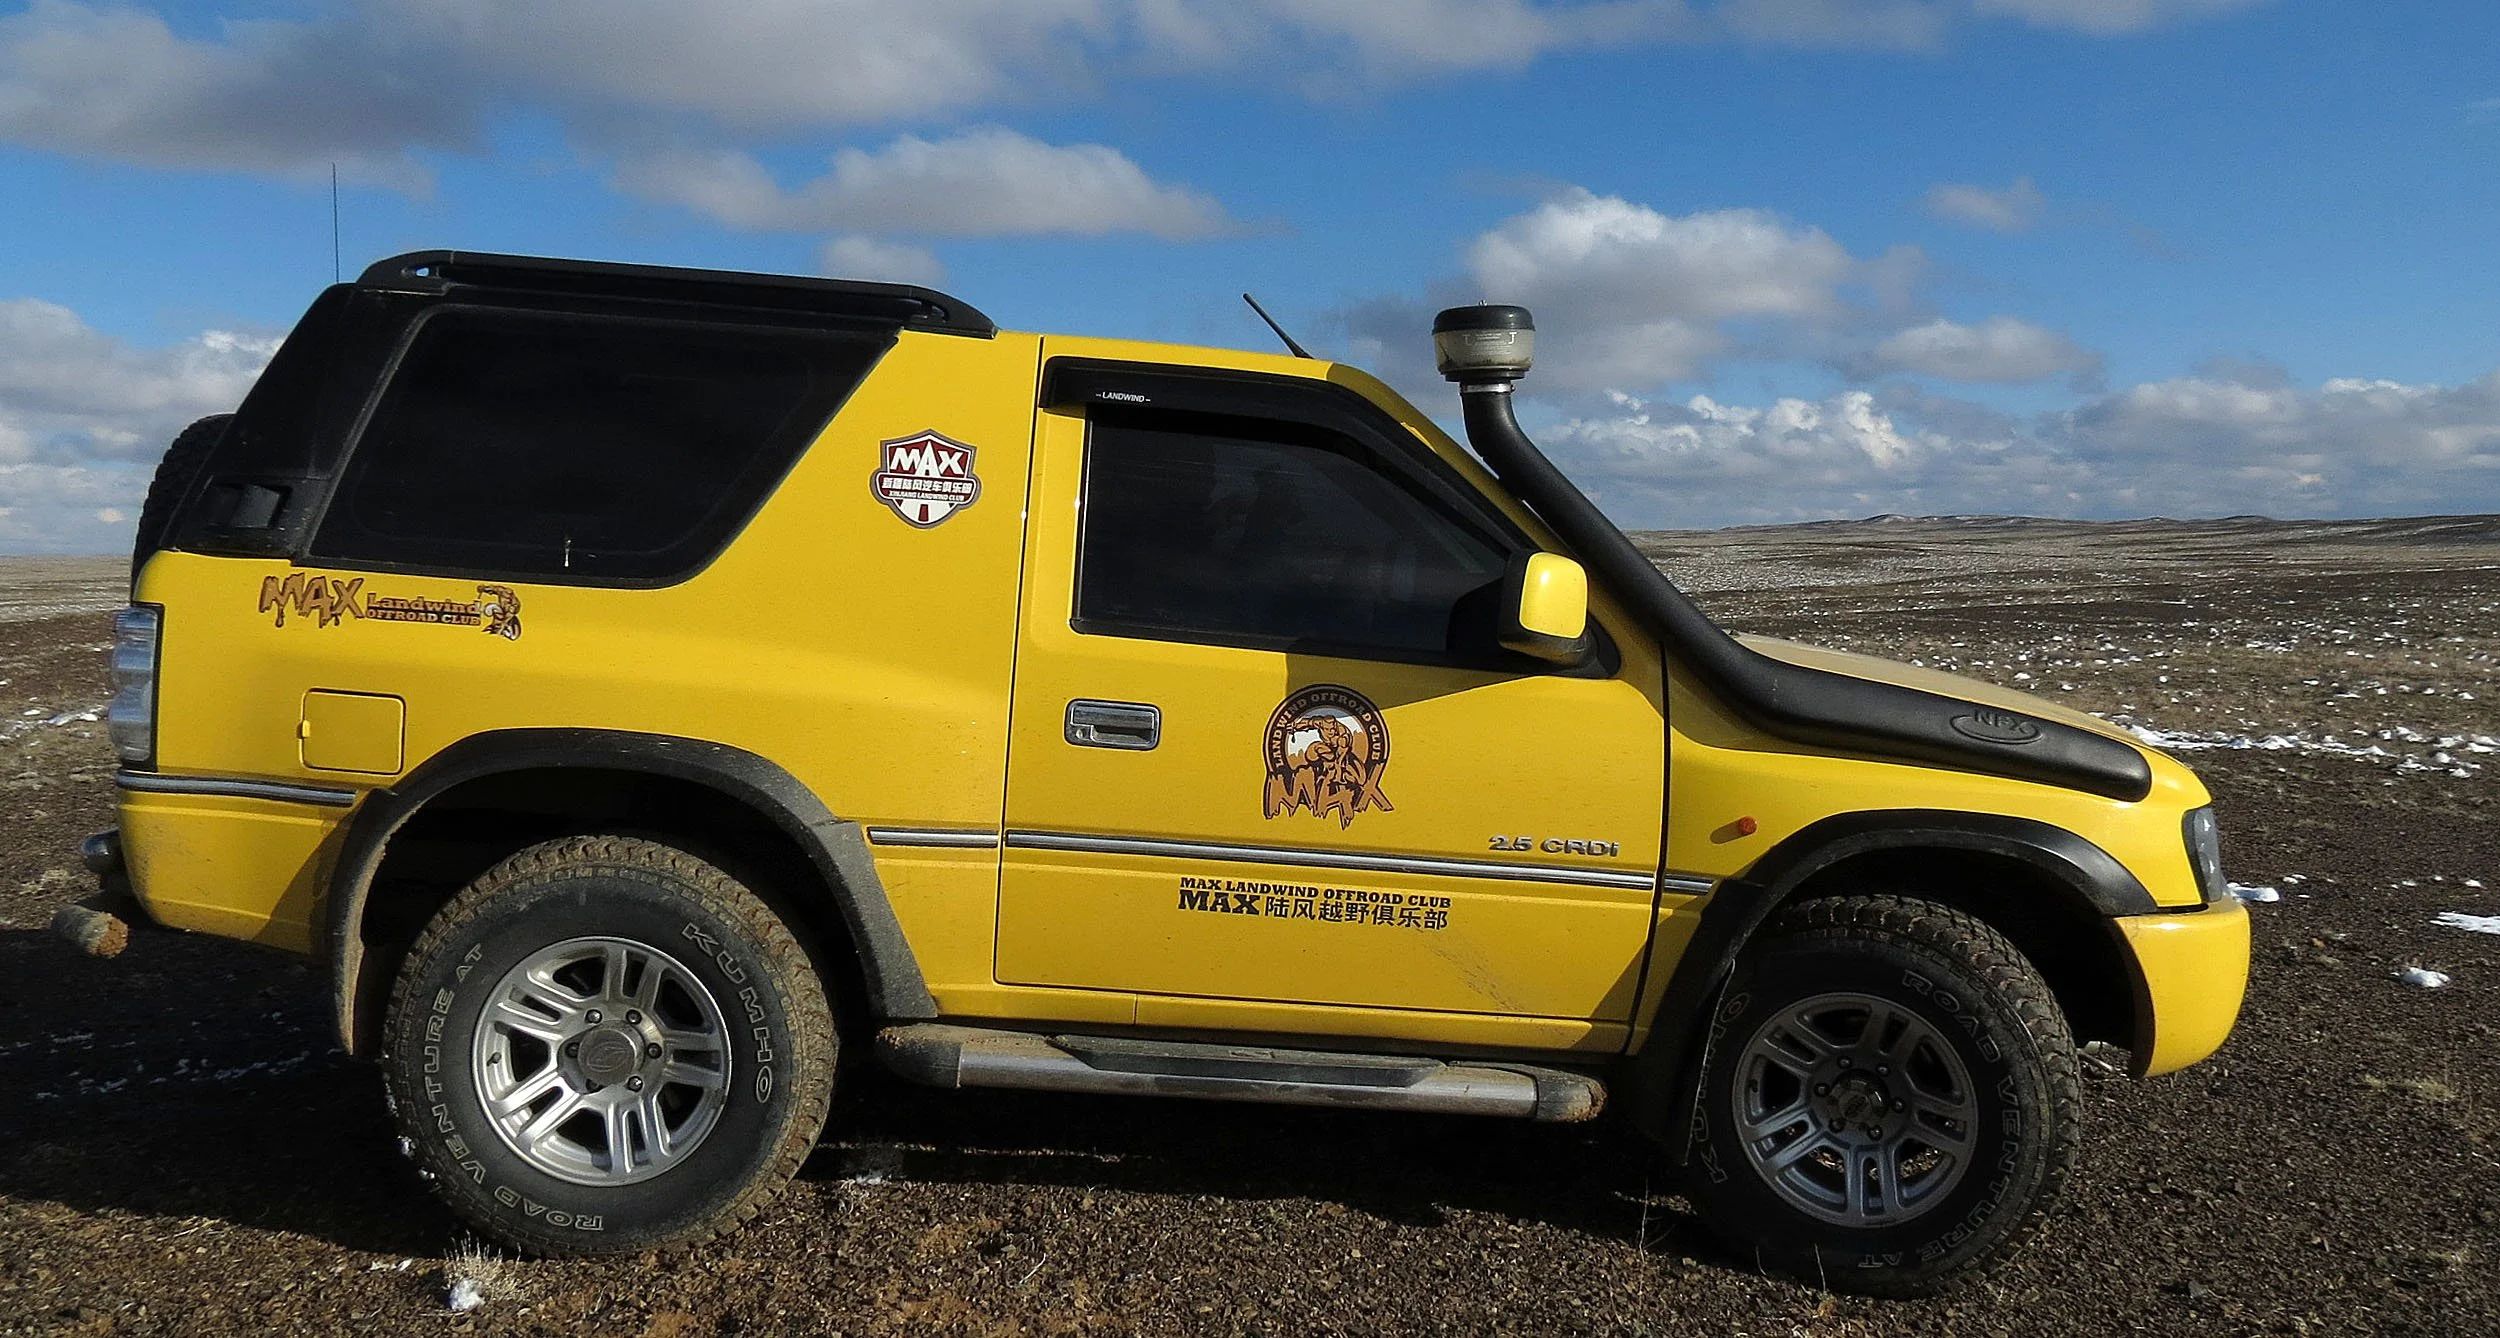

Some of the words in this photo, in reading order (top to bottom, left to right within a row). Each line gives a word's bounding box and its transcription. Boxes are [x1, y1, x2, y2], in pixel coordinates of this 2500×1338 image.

[890, 440, 965, 477] MAX
[259, 572, 364, 628] MAX
[367, 592, 481, 615] Landwind
[367, 608, 438, 623] OFFROAD
[441, 613, 480, 626] CLUB
[1272, 698, 1307, 768] LANDWIND
[1311, 692, 1373, 723] OFFROAD
[1369, 723, 1382, 762] CLUB
[1263, 762, 1395, 831] MAX
[1178, 889, 1260, 915] MAX
[1264, 895, 1448, 931] 陆风越野俱乐部
[1180, 877, 1222, 890] MAX
[1225, 880, 1319, 898] LANDWIND
[1323, 888, 1404, 905] OFFROAD
[1407, 894, 1452, 908] CLUB
[456, 942, 484, 983] AT
[680, 921, 773, 1104] KUMHO
[1902, 968, 2001, 1064] ROAD
[423, 987, 487, 1184] VENTURE
[1916, 1073, 2021, 1262] VENTURE
[493, 1184, 604, 1232] ROAD
[1858, 1251, 1904, 1269] AT
